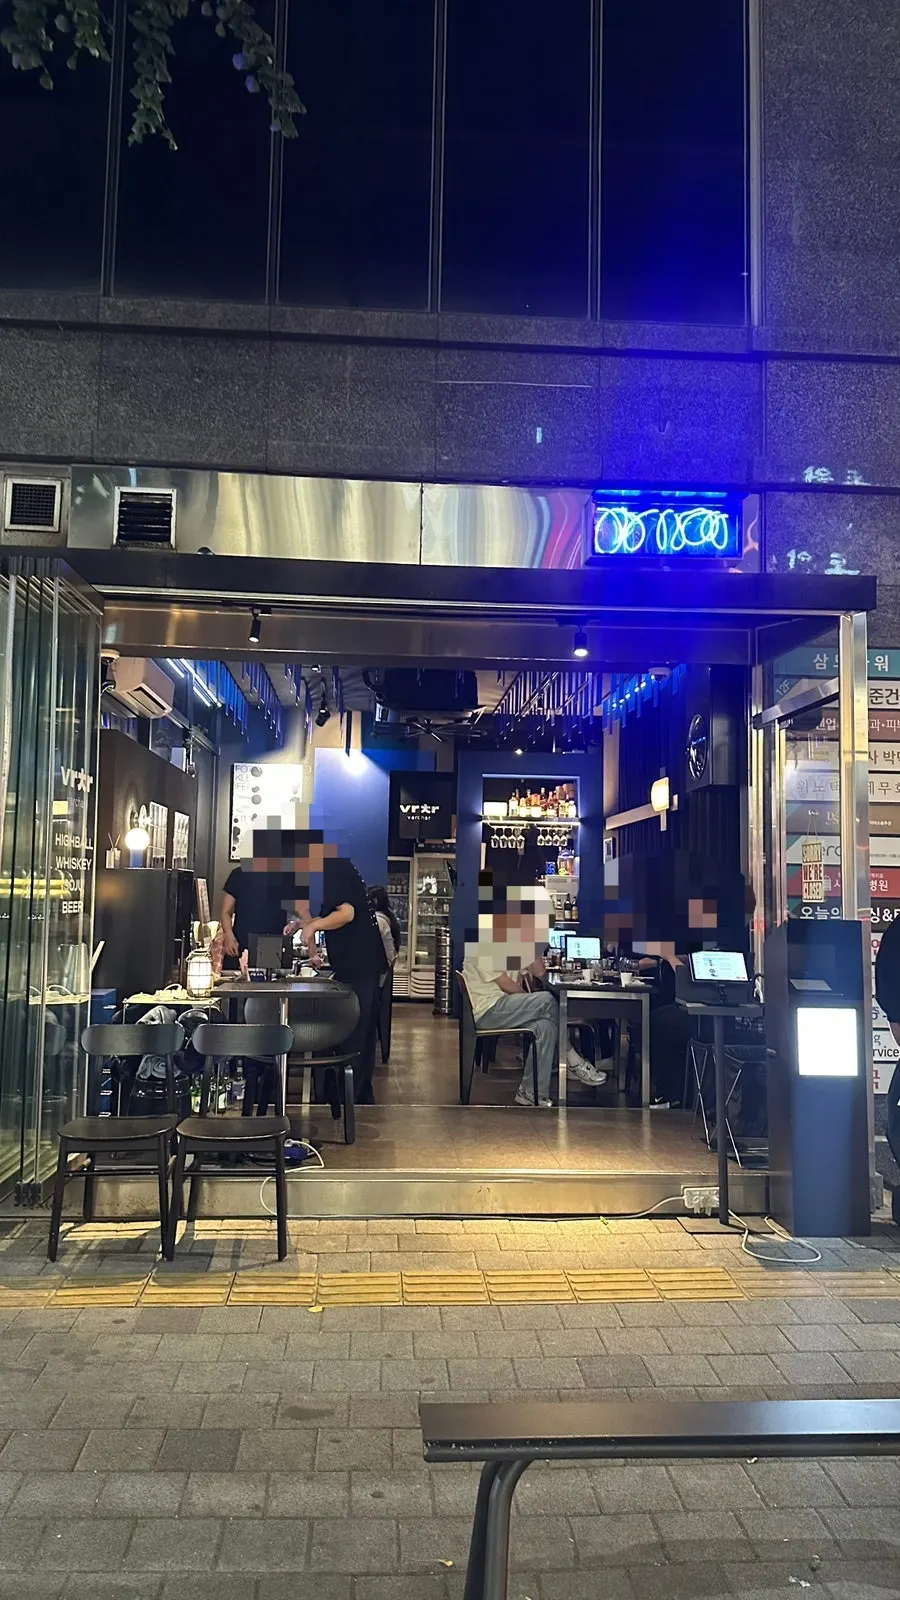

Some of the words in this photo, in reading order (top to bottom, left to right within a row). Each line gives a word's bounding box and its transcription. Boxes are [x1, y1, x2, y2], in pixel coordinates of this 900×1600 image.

[775, 680, 791, 697] 12F
[54, 832, 94, 850] HIGHBALL
[55, 855, 92, 871] WHISKEY
[61, 900, 84, 914] BEER
